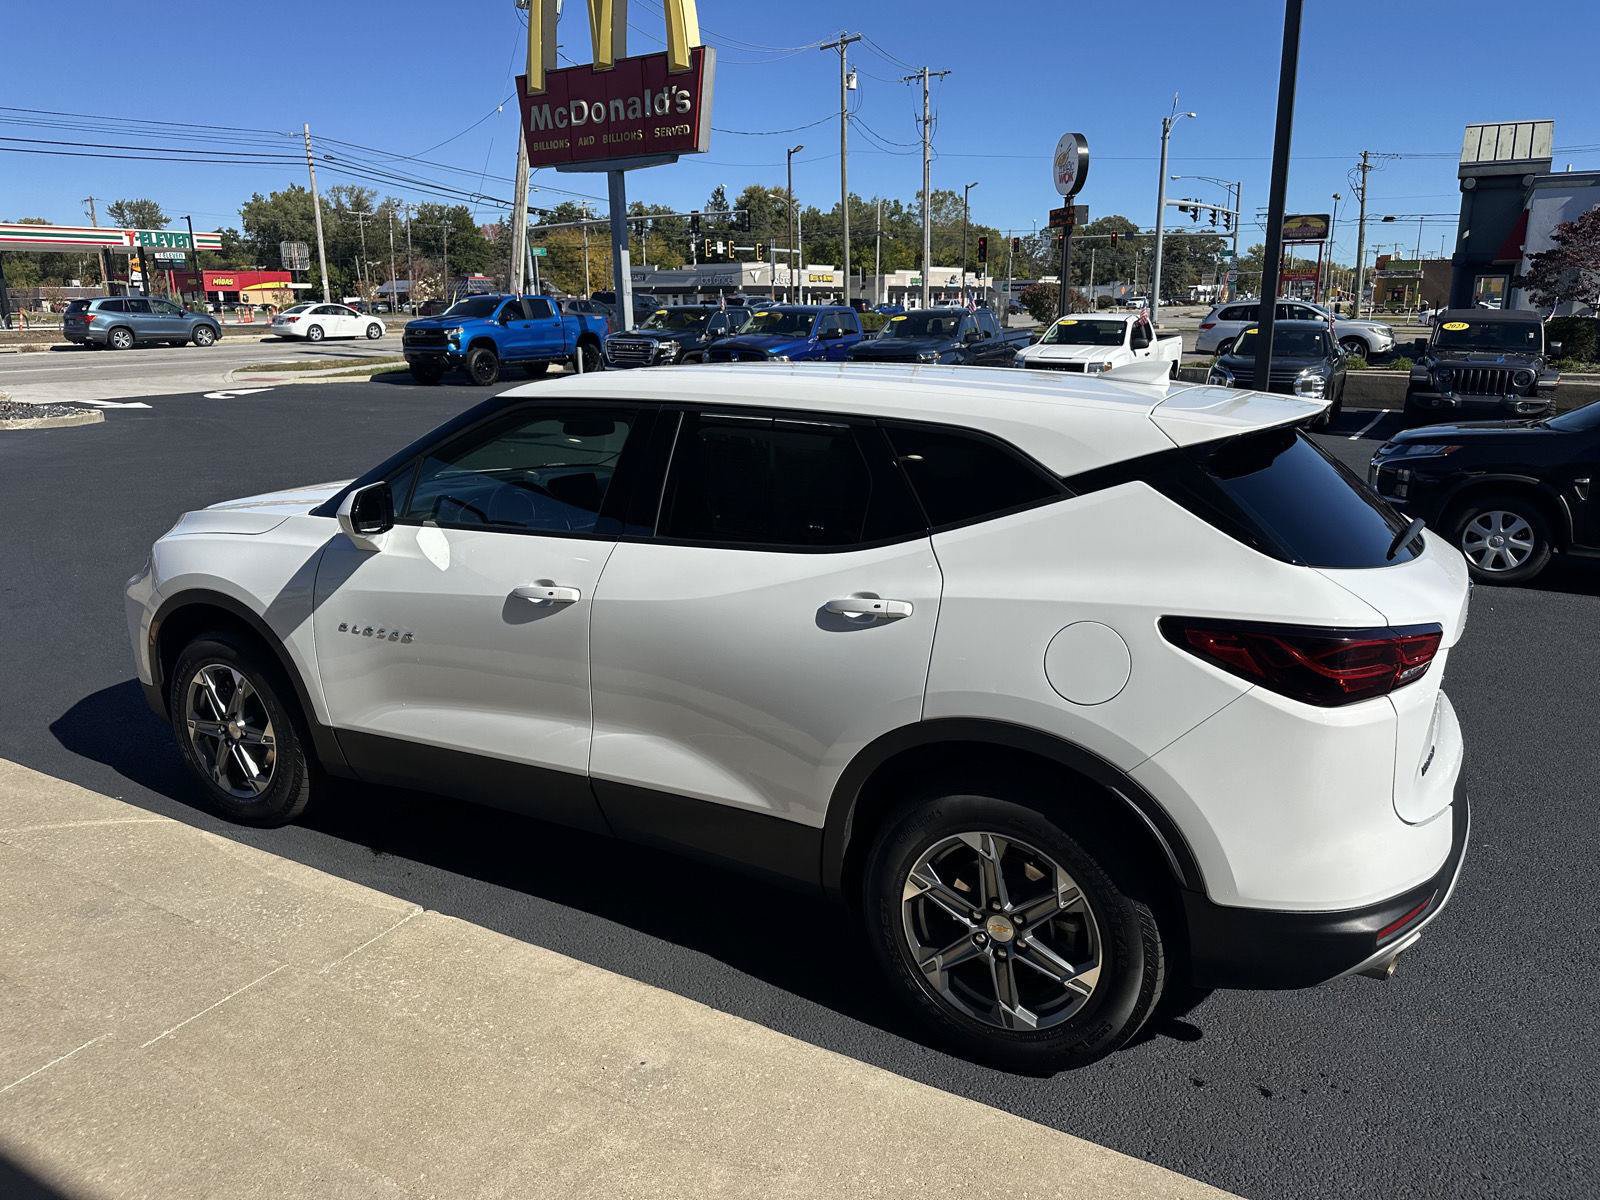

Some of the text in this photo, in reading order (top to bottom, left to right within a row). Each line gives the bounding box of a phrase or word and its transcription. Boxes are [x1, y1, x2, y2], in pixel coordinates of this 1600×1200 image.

[530, 85, 691, 132] McDonald's
[533, 124, 690, 151] BILLIONS AND BILLIONS SERVED
